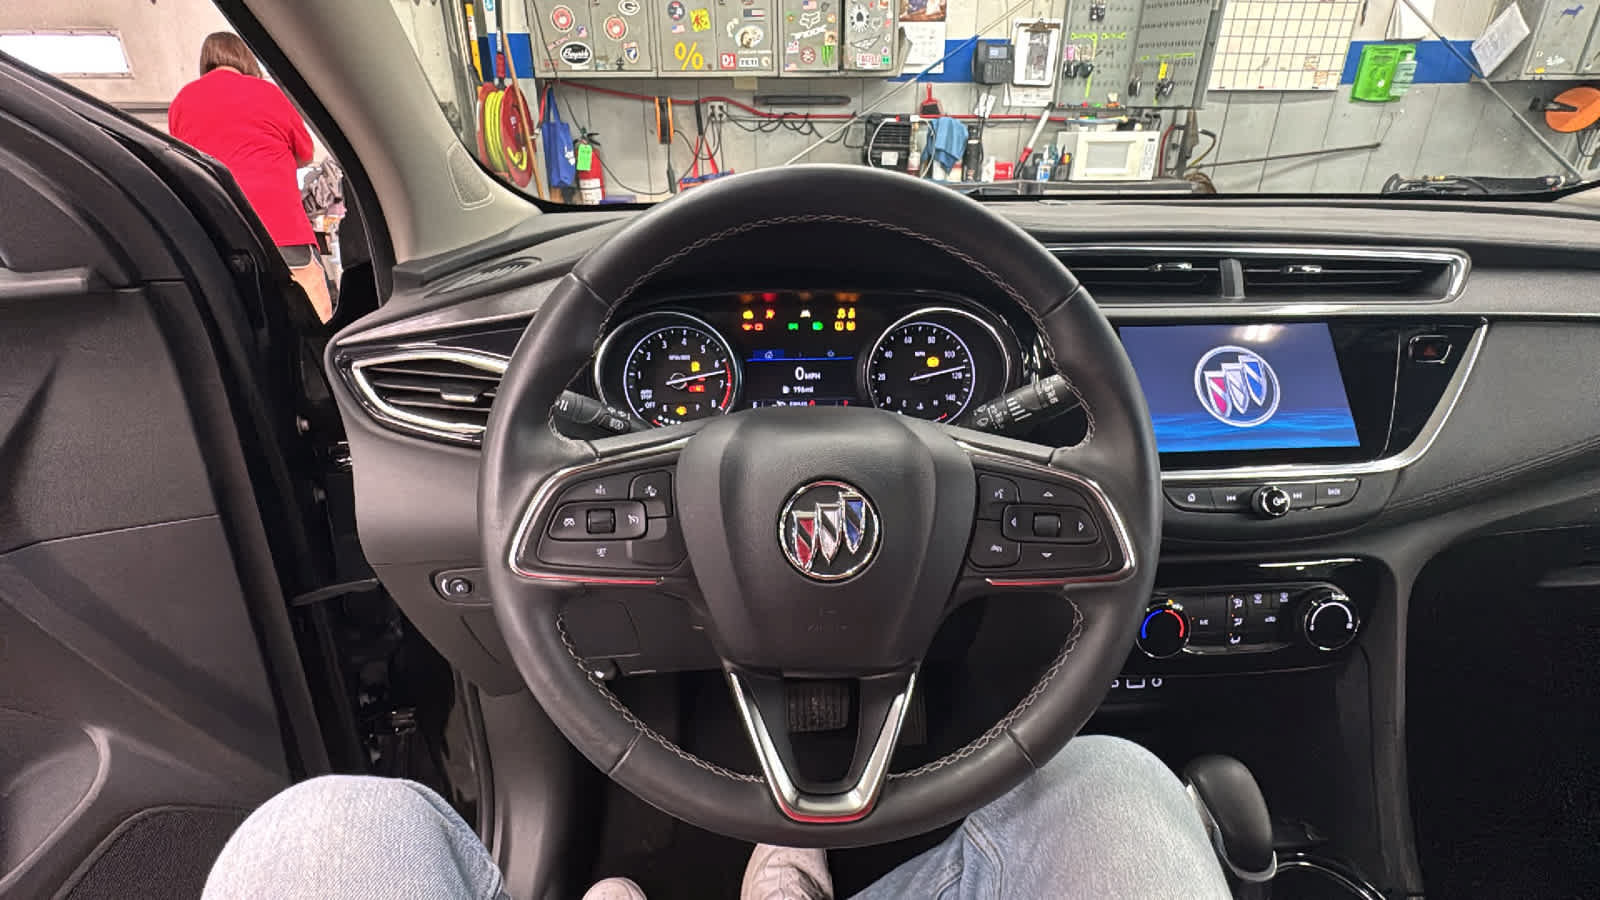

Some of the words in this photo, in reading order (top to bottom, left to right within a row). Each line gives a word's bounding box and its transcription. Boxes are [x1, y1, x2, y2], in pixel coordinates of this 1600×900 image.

[662, 340, 667, 349] 3
[681, 337, 687, 346] 4
[904, 336, 912, 344] 60
[927, 336, 936, 344] 80
[700, 344, 706, 354] 5
[646, 351, 651, 361] 2
[884, 350, 893, 359] 40
[944, 350, 956, 359] 100
[714, 360, 720, 369] 6
[795, 366, 805, 380] 0
[878, 372, 886, 381] 20
[952, 371, 963, 380] 120
[719, 380, 724, 389] 7
[886, 395, 892, 404] 0
[945, 393, 956, 401] 140
[644, 401, 656, 409] OFF
[711, 399, 717, 408] 8
